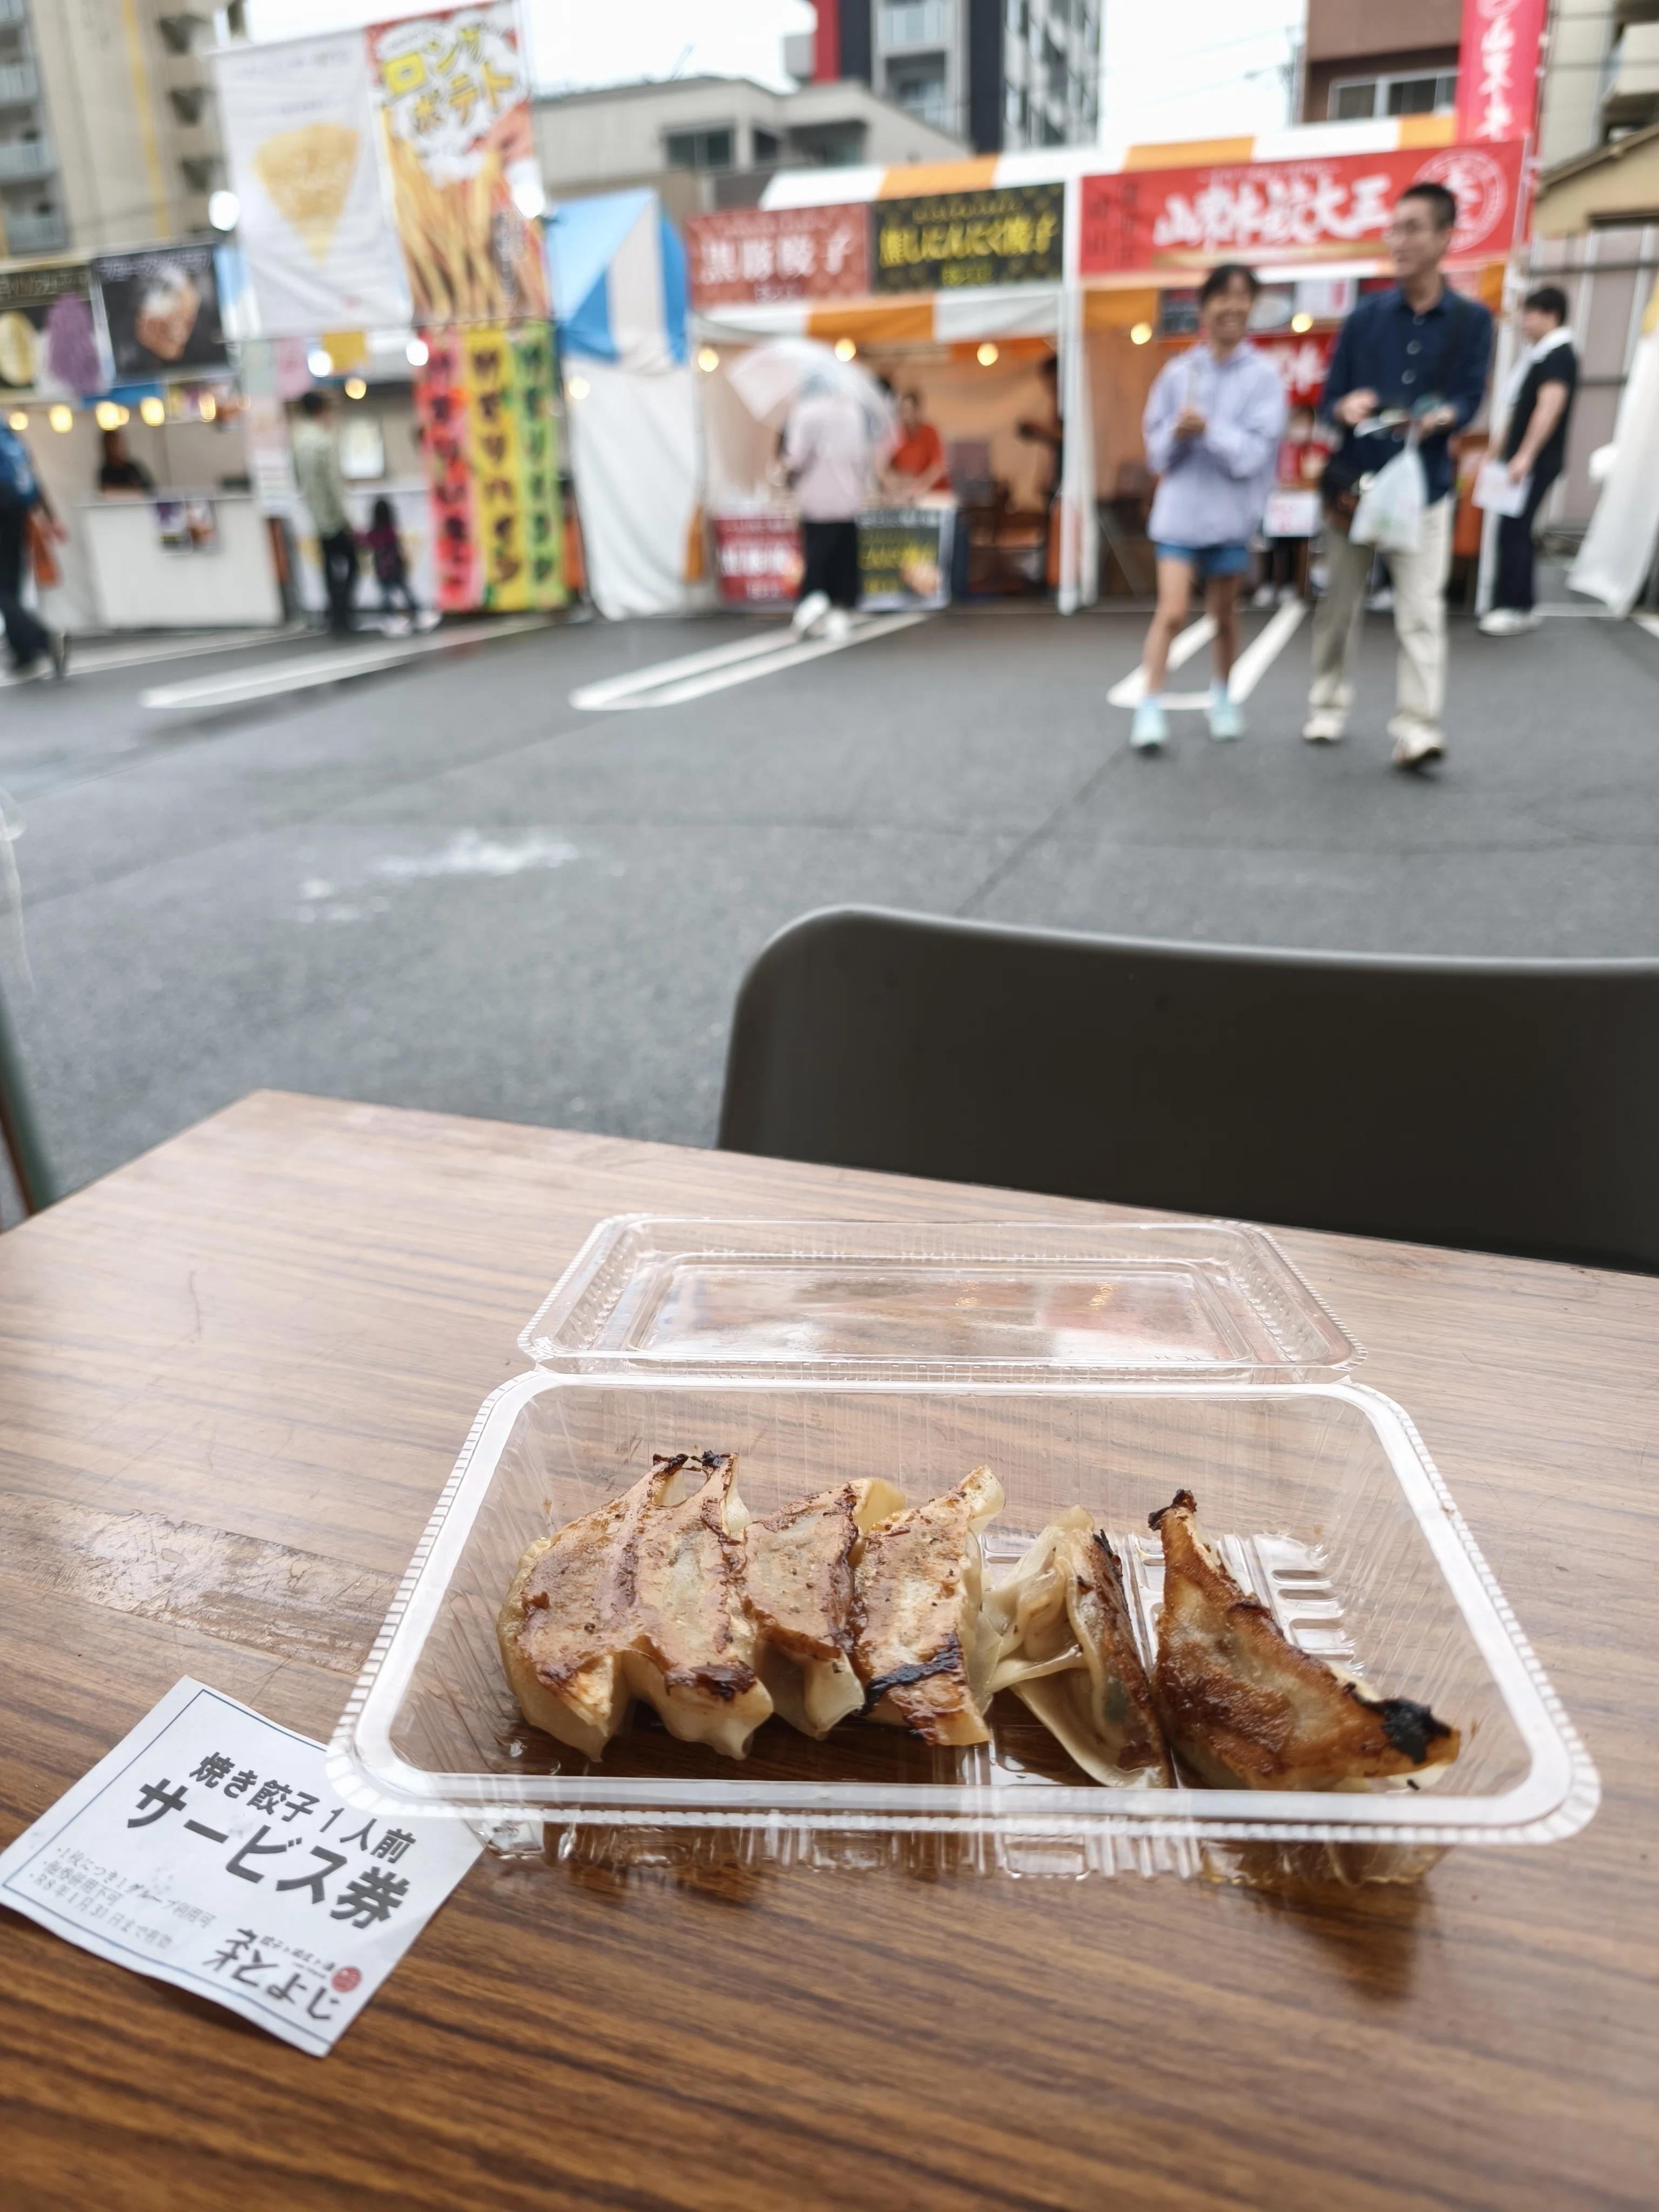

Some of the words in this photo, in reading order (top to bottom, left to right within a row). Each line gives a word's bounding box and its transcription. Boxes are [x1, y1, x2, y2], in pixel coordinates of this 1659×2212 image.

[382, 24, 484, 98] ロング
[413, 57, 516, 135] ポテト
[127, 1778, 411, 1930] サービス券
[188, 1751, 417, 1864] 焼き餃子1人前
